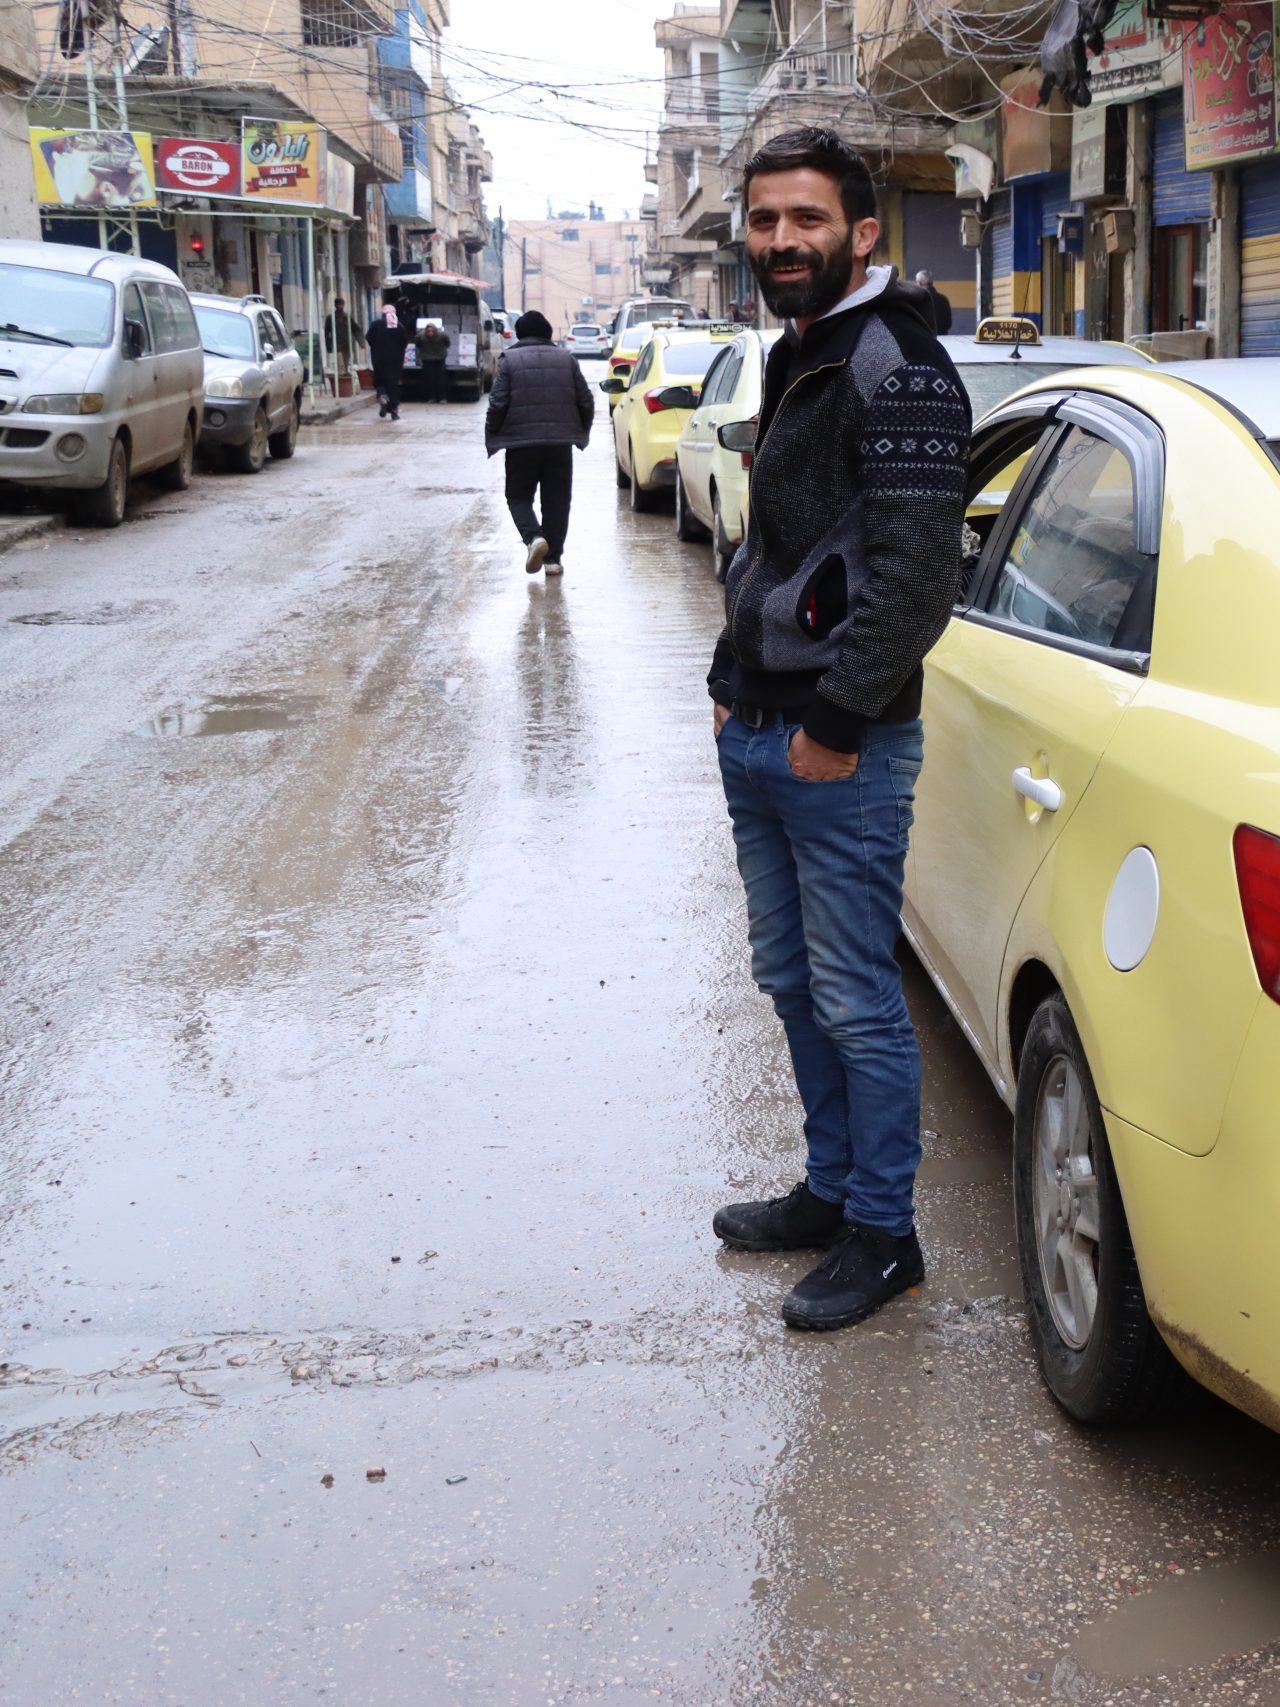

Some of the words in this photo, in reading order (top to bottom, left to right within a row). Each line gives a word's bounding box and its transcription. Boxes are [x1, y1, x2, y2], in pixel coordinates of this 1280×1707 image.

[247, 133, 310, 165] البارون
[181, 160, 213, 172] BARON
[258, 176, 288, 187] الرجالية
